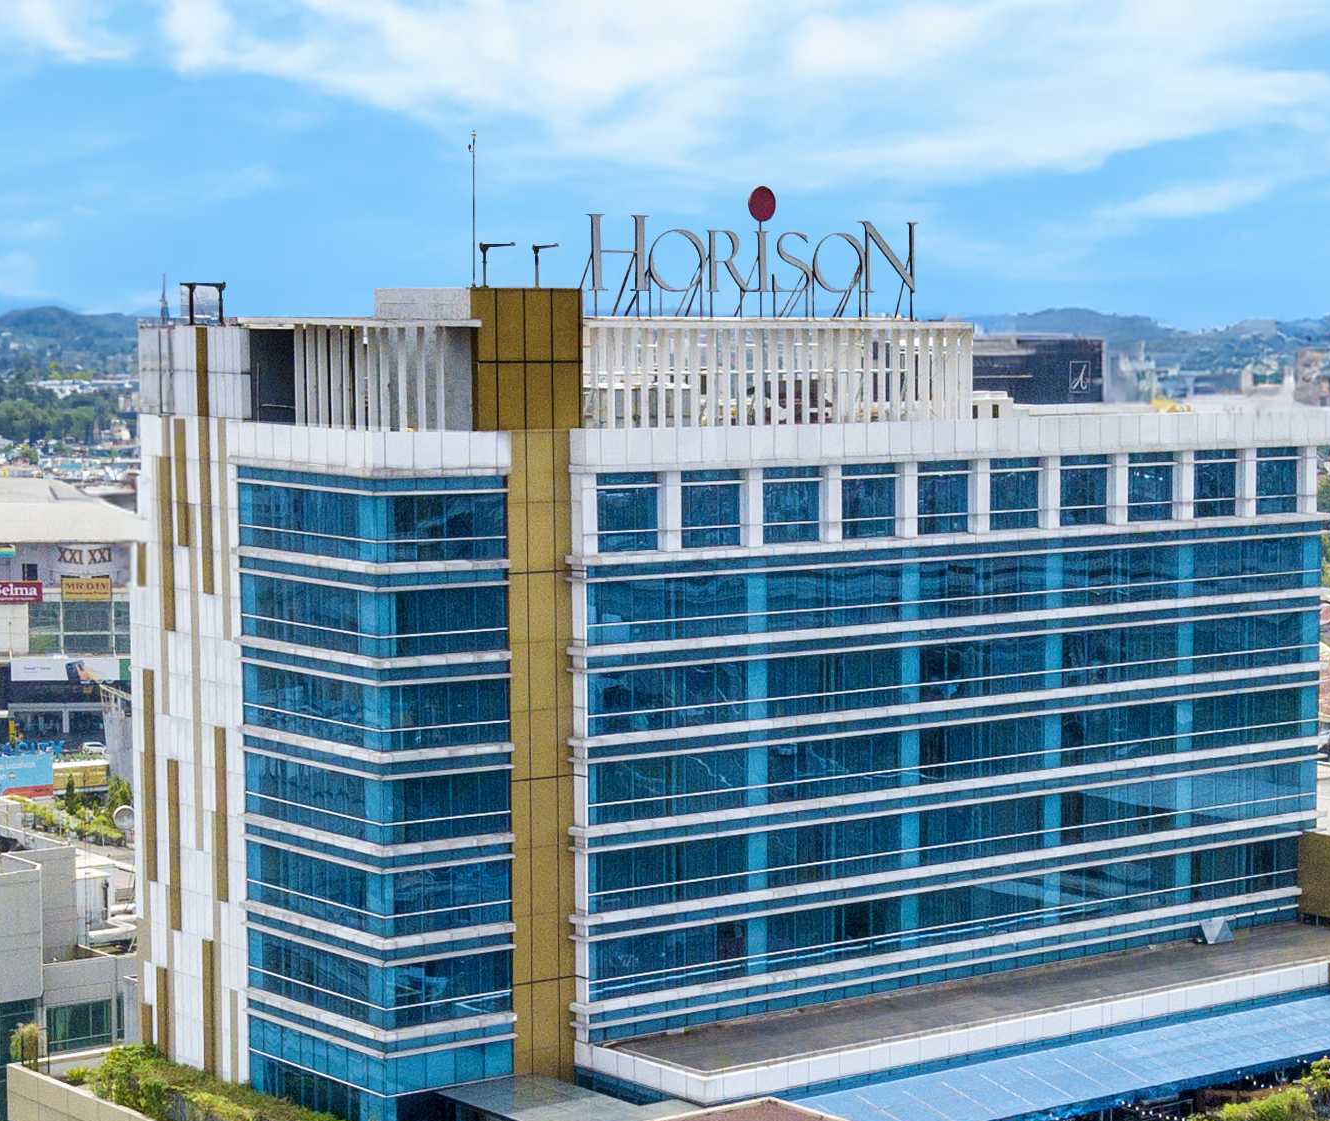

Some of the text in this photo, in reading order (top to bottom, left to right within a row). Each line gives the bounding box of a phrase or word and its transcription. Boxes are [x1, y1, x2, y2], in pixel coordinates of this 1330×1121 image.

[586, 212, 919, 294] HORISON
[58, 546, 112, 565] XXI XXI
